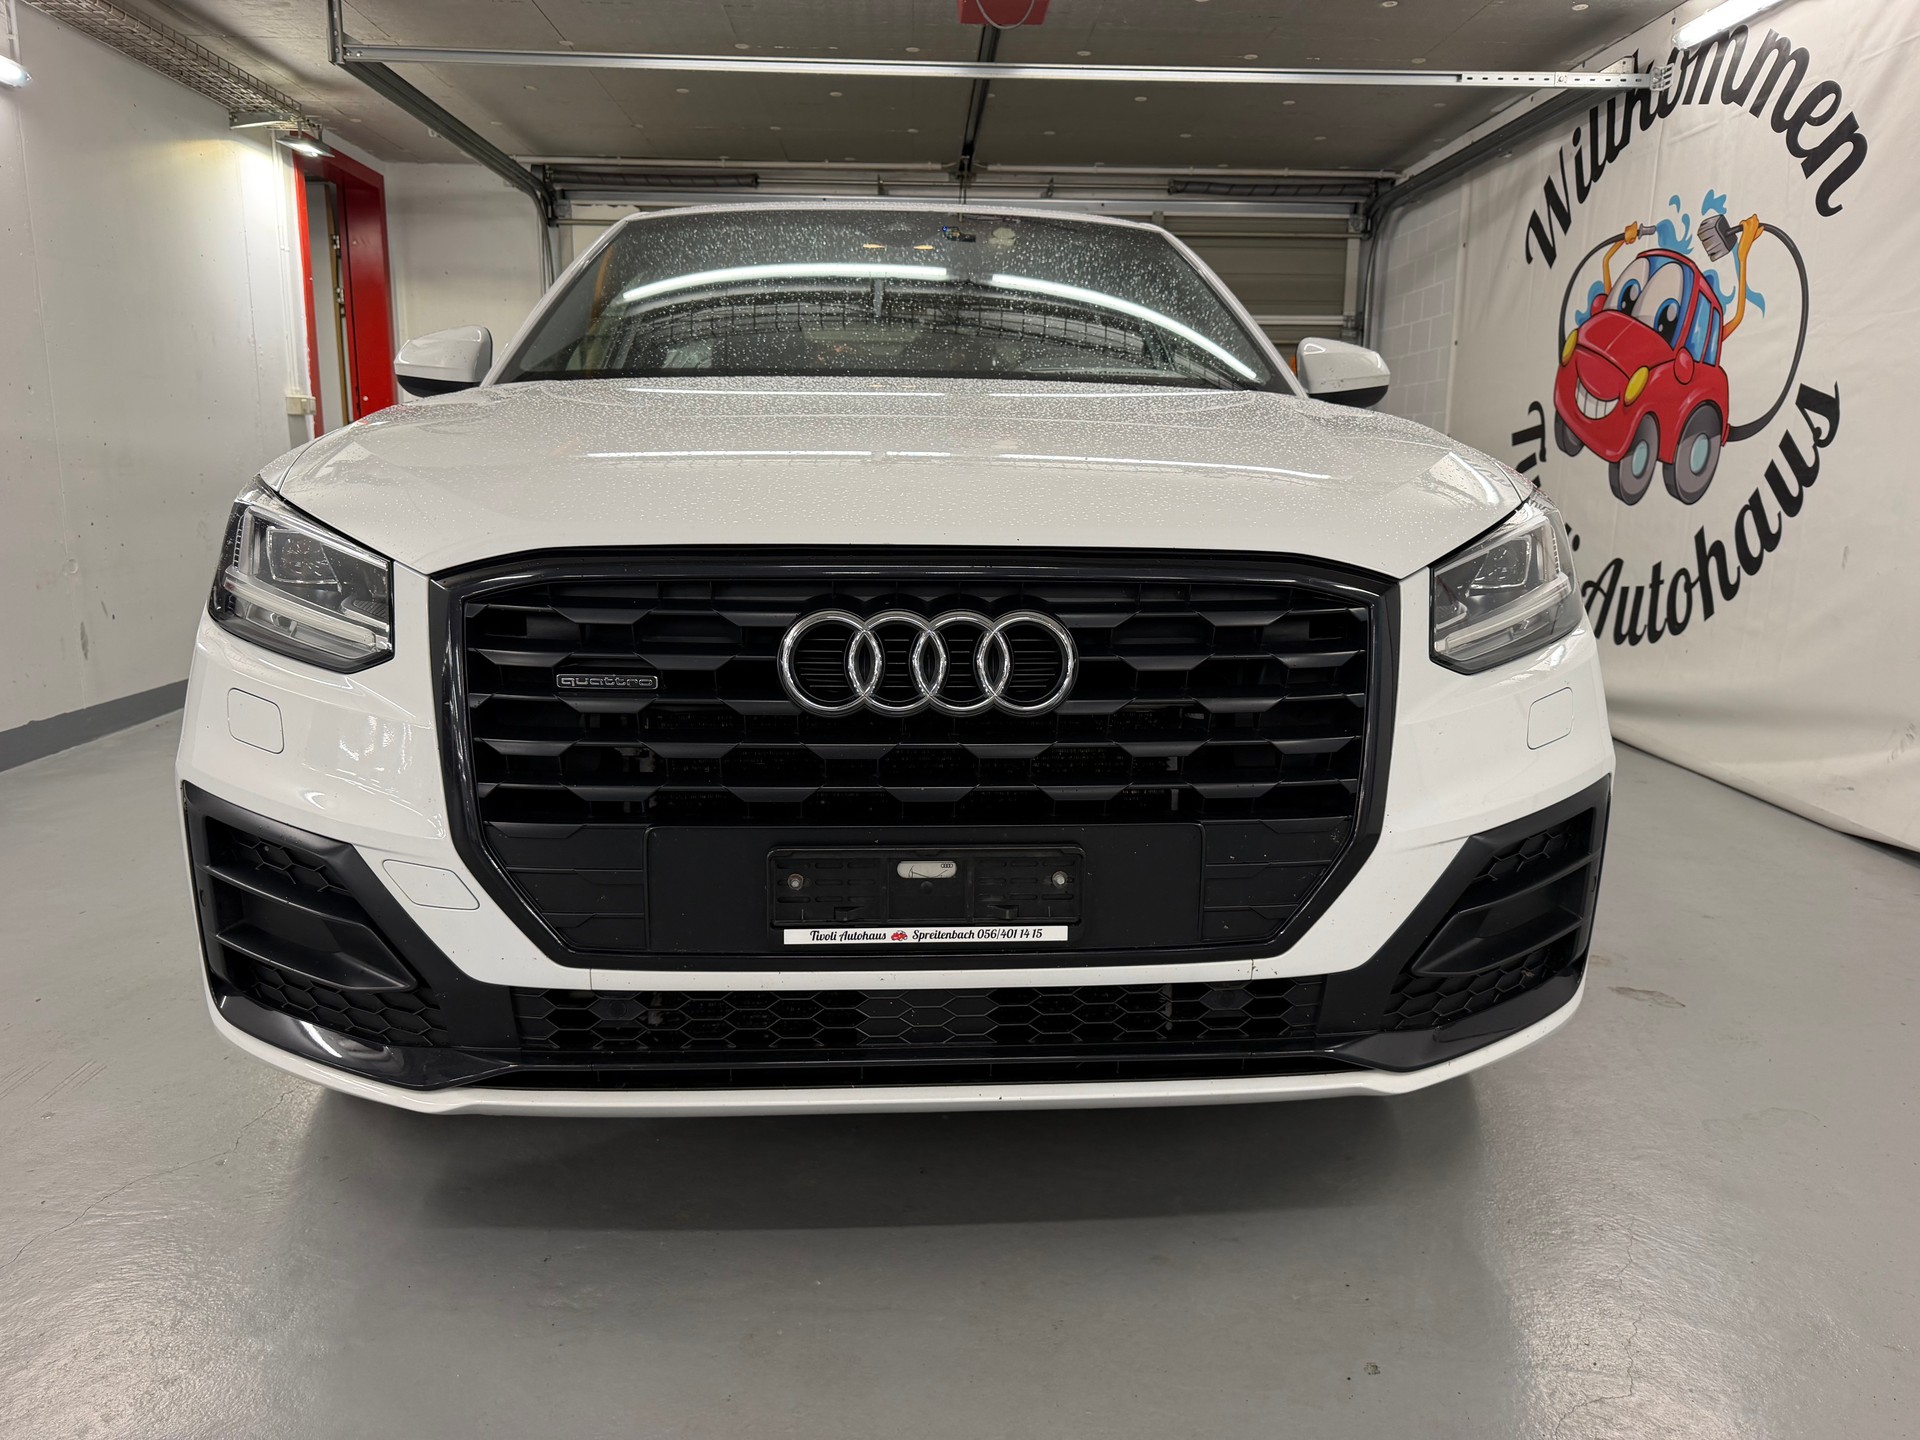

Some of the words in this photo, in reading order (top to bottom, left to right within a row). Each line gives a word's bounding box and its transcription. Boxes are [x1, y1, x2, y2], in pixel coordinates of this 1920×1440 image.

[1525, 24, 1868, 269] Willkommen
[1582, 381, 1840, 646] Autohaus
[560, 676, 653, 687] quattro
[810, 930, 837, 941] Tivoli
[839, 930, 887, 942] Autohaus
[912, 929, 975, 942] Spreitenbach
[977, 929, 1018, 941] 056/401
[1019, 929, 1030, 940] 14
[1032, 928, 1043, 939] 15
